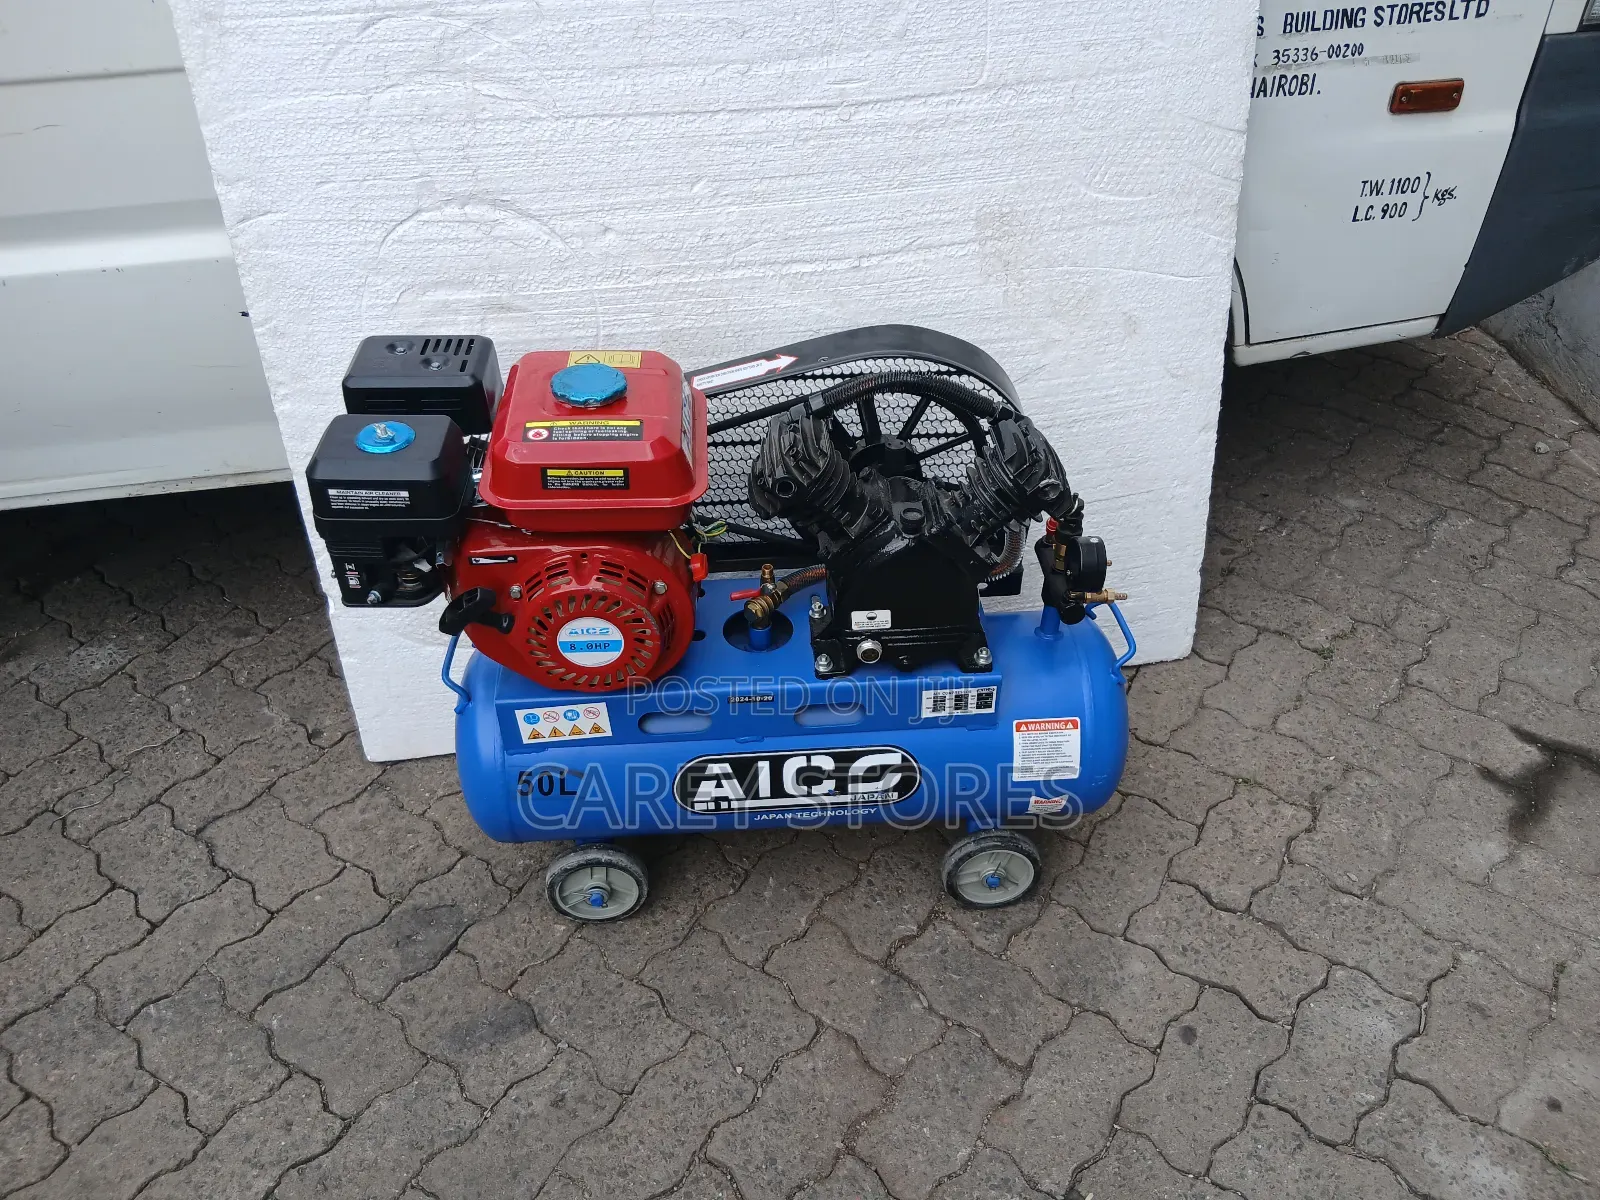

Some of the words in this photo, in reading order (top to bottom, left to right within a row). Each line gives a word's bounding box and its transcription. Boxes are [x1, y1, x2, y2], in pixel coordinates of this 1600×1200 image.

[1282, 6, 1367, 34] BUILDING
[1373, 1, 1446, 27] STORES
[1448, 0, 1490, 21] LTD
[1271, 42, 1365, 66] 35336-00200
[1388, 176, 1421, 195] 1100
[1351, 205, 1376, 222] L.C.
[1380, 201, 1408, 220] 900
[1027, 721, 1066, 731] WARNING
[517, 770, 577, 797] 50L
[754, 812, 793, 821] JAPAN
[795, 807, 878, 819] TECHNOLOGY
